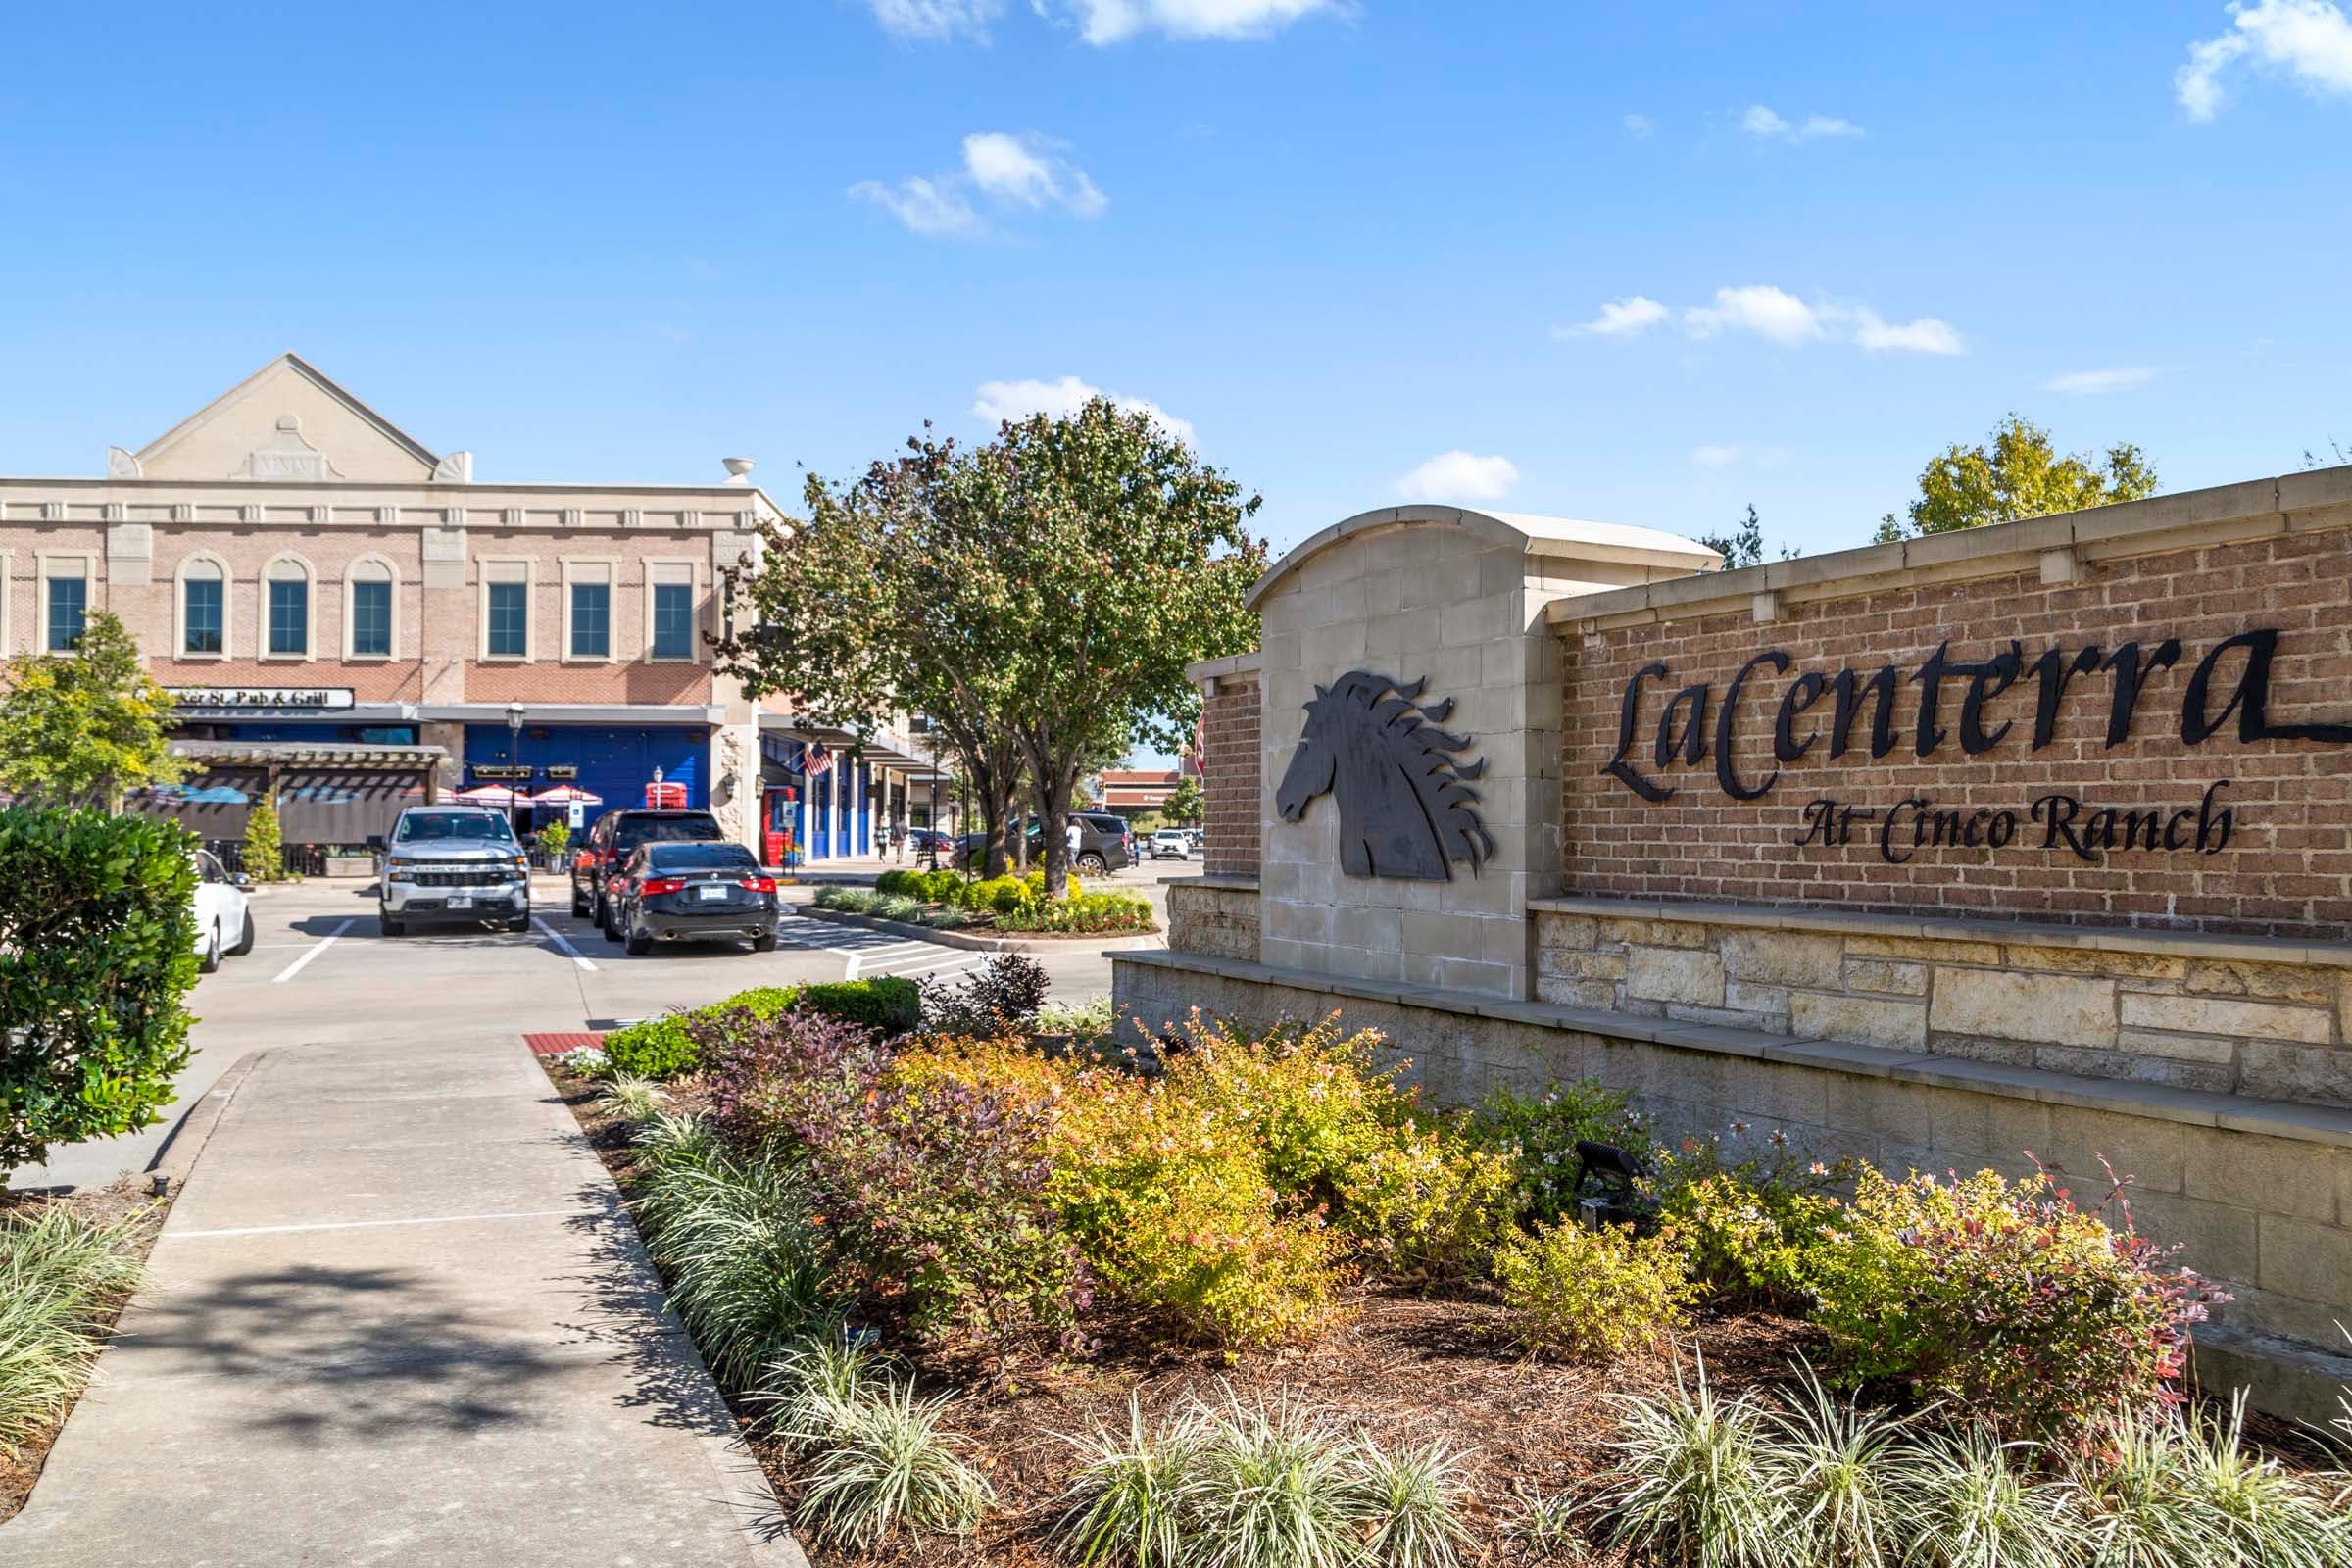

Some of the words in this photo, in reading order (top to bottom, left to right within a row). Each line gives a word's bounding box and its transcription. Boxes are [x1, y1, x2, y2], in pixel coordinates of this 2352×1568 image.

[210, 691, 231, 704] St.
[236, 691, 268, 704] Pub
[273, 691, 285, 704] &
[291, 691, 328, 704] Grill
[1794, 799, 1875, 847] At
[1880, 798, 2017, 864] Cinco
[2030, 780, 2232, 862] Ranch
